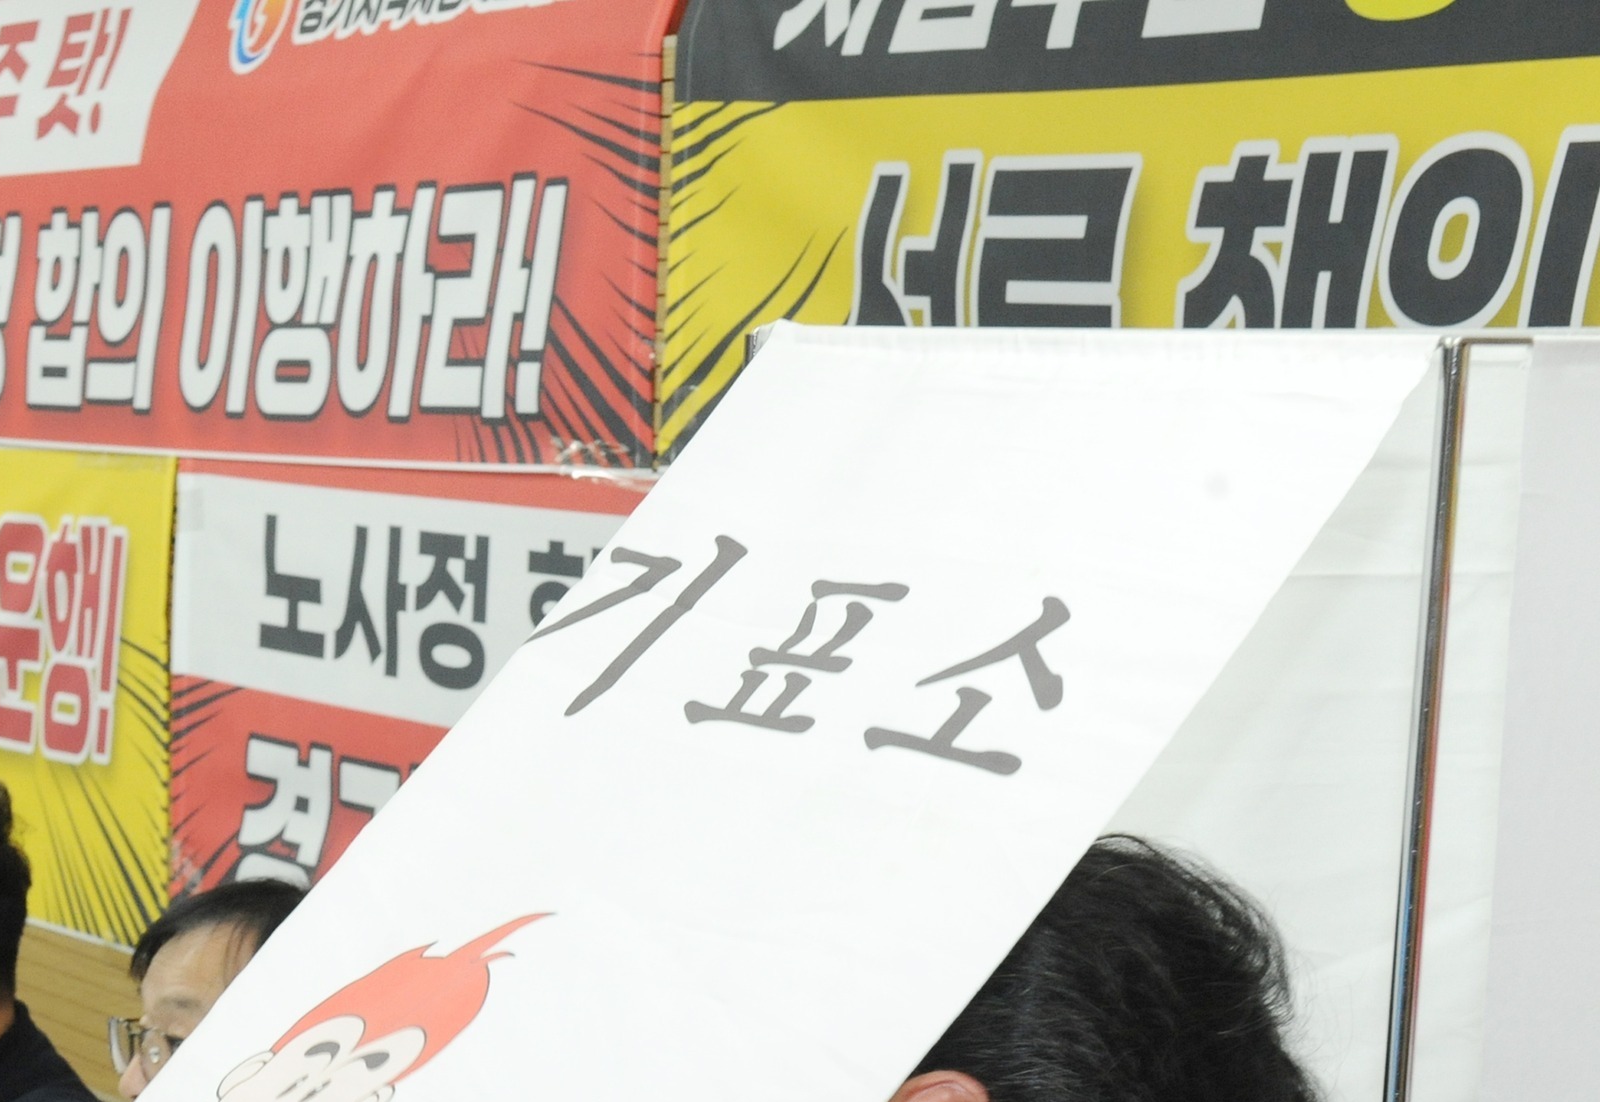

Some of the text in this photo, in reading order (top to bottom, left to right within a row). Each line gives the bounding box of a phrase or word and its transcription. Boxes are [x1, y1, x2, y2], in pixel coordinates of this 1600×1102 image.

[35, 7, 134, 140] 탓!
[25, 202, 172, 413] 합의
[178, 171, 570, 422] 이행하라!
[259, 514, 491, 691] 노사정
[522, 534, 1071, 777] 기표소
